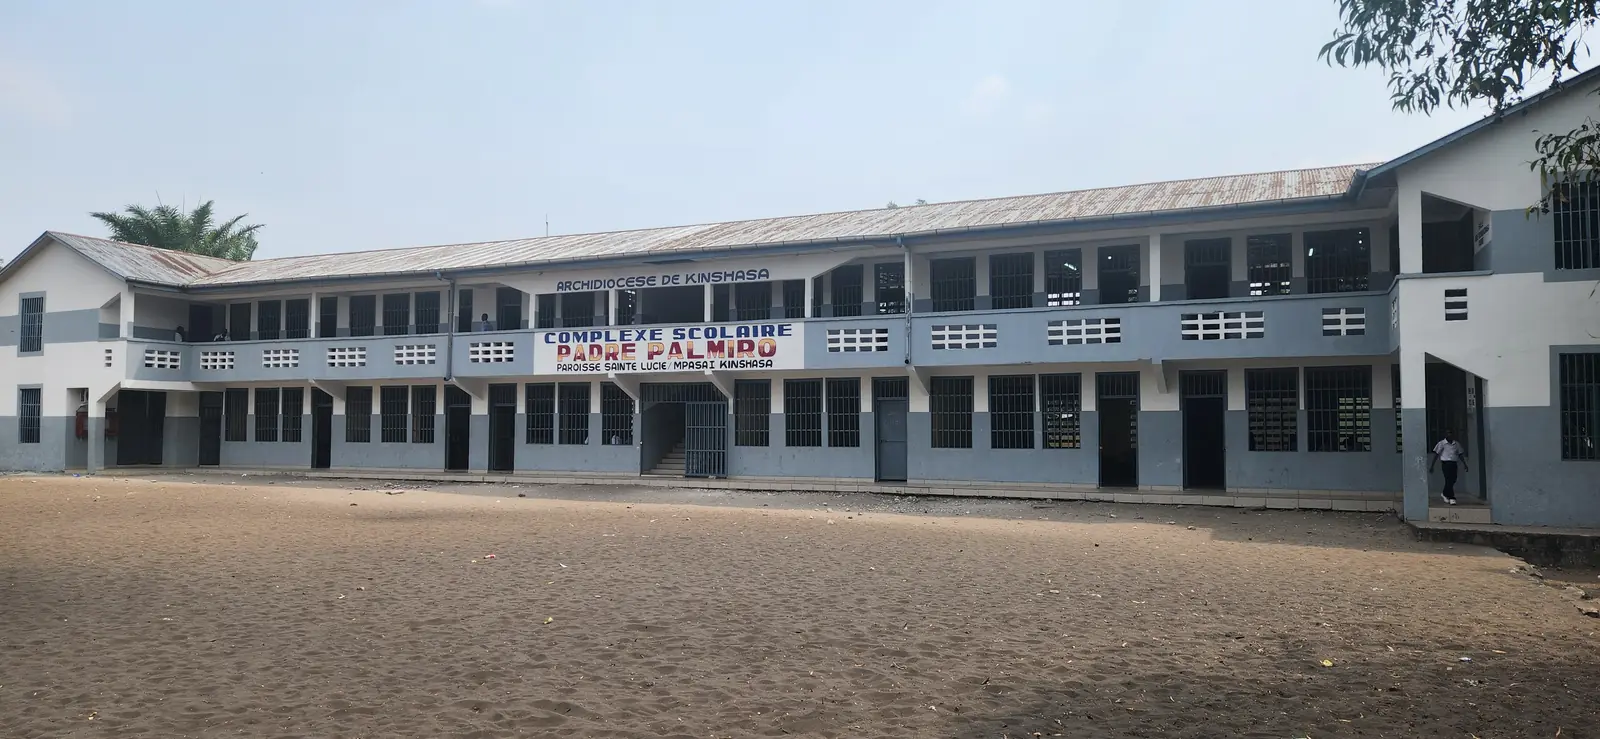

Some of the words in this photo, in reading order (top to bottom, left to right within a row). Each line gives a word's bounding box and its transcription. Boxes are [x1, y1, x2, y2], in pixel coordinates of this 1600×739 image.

[556, 275, 657, 292] ARCHIDIOCESE
[661, 274, 680, 286] DE
[685, 268, 770, 285] KINSHASA
[544, 328, 663, 344] COMPLEXE
[672, 323, 793, 340] SCOLAIRE
[557, 342, 636, 362] PADRE
[647, 338, 777, 360] PALMIRO
[556, 362, 601, 372] PAROISSE
[604, 361, 637, 371] SAINTE
[719, 359, 773, 369] KINSHASA
